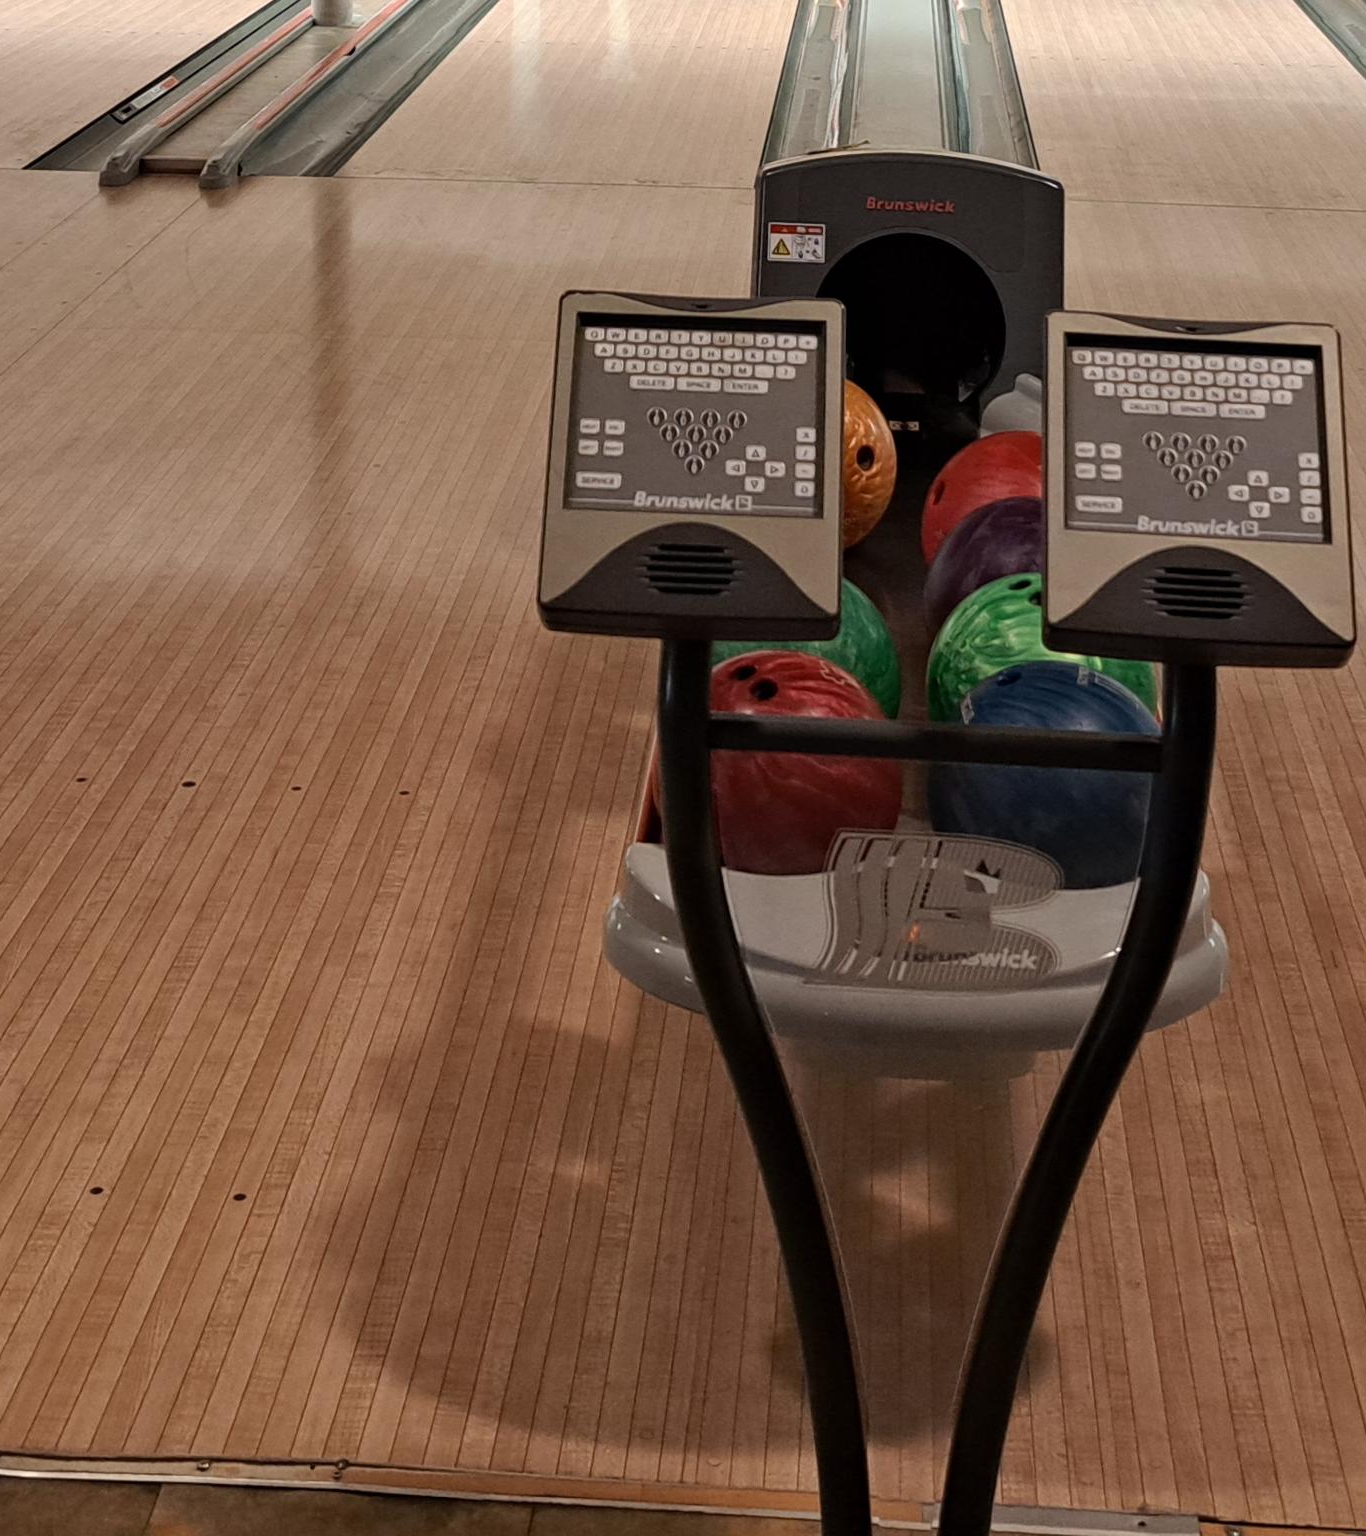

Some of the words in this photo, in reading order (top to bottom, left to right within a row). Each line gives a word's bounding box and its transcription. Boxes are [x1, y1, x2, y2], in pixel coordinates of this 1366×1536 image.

[865, 195, 956, 214] Brunswick
[633, 490, 735, 511] Brunswick
[1137, 515, 1241, 536] Brunswick
